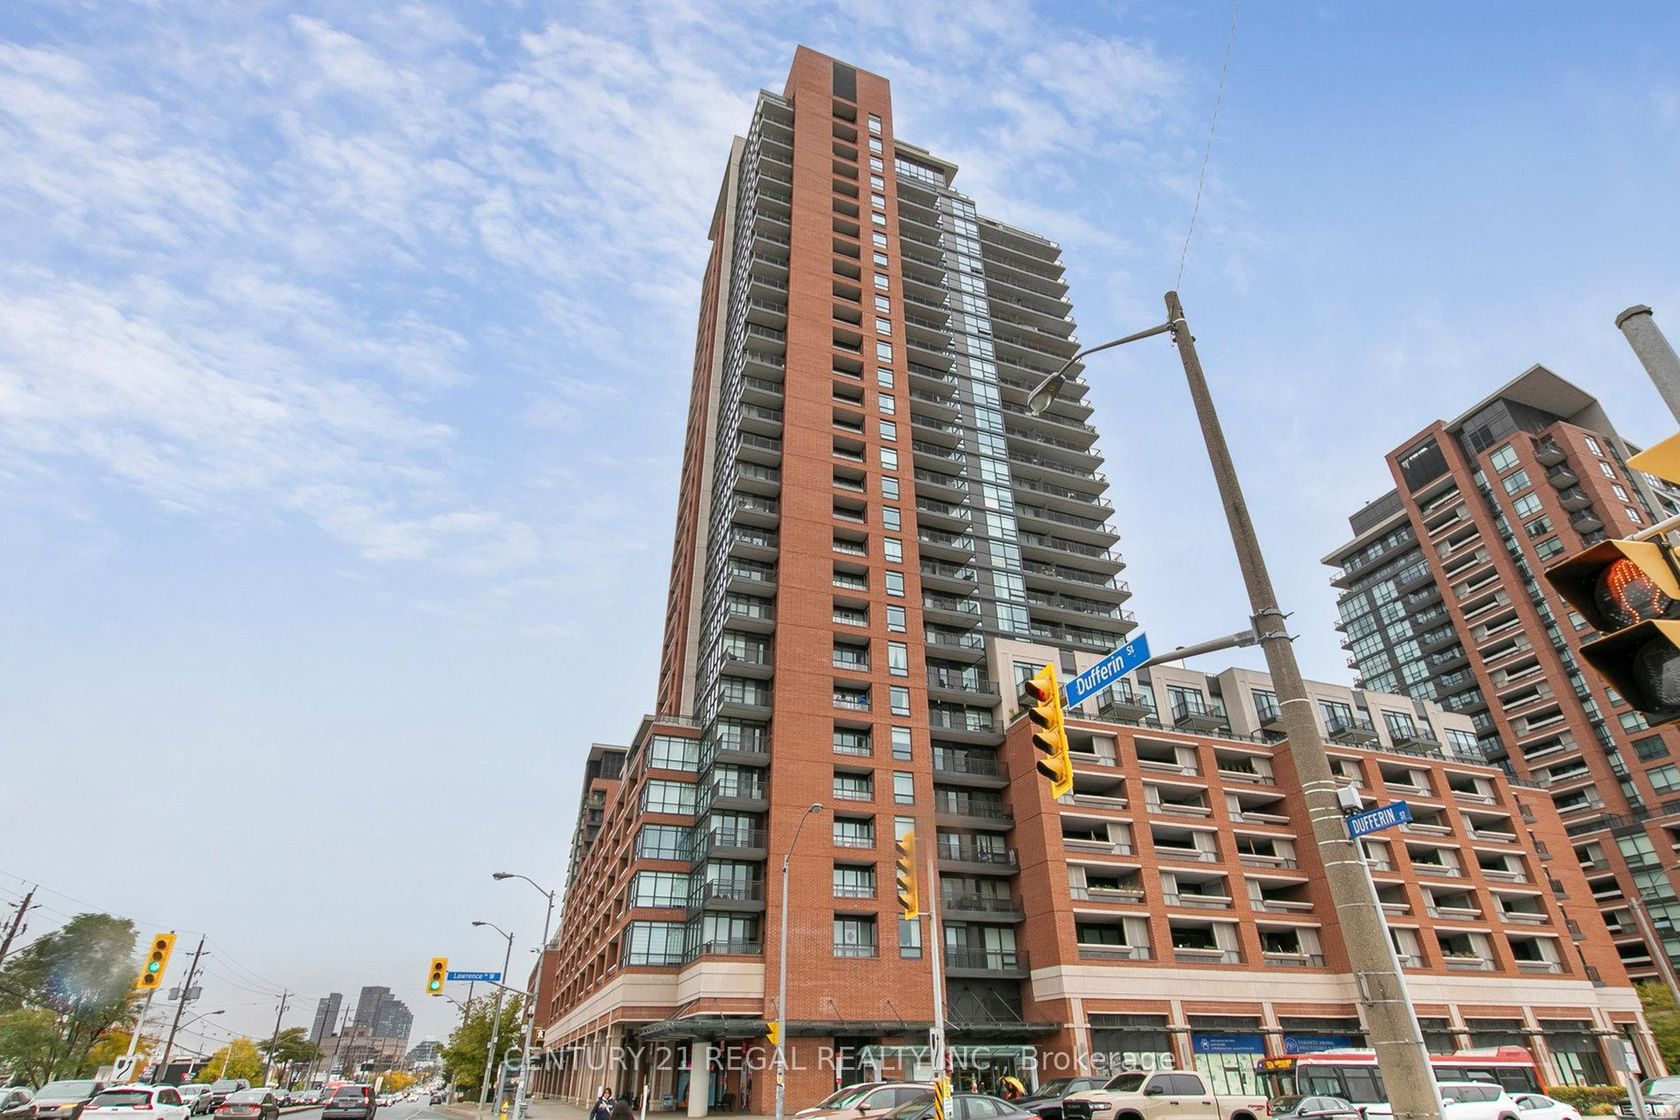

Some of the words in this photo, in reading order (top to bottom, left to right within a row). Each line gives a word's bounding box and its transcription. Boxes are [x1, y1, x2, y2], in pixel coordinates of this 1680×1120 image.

[1076, 656, 1125, 695] Dufferin
[1126, 645, 1135, 656] St
[1352, 808, 1396, 833] DUFFERIN
[453, 972, 483, 980] Lawrence
